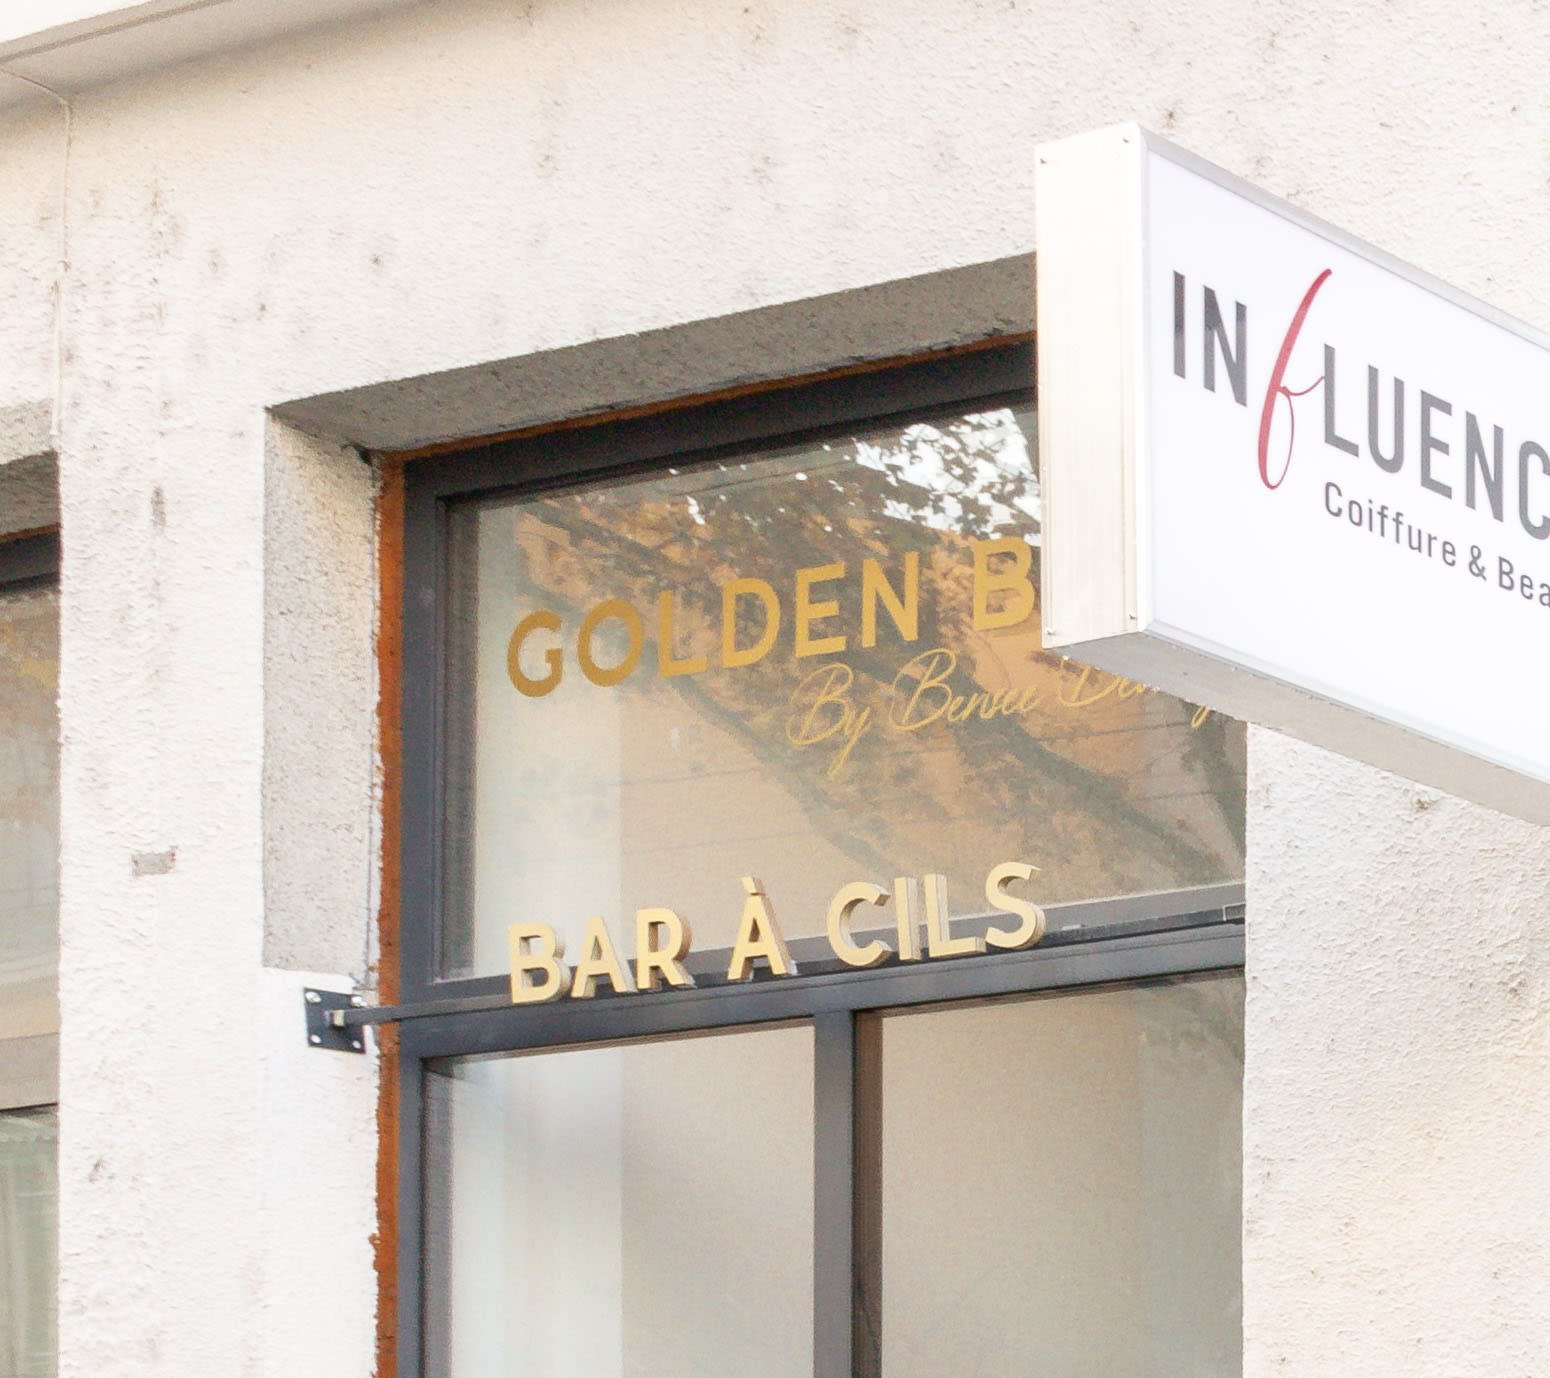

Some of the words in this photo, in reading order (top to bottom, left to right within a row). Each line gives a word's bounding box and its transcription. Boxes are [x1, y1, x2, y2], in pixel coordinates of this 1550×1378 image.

[1324, 481, 1457, 570] Coiffure
[1467, 544, 1488, 582] &
[506, 550, 922, 698] GOLDEN
[787, 662, 871, 777] By
[508, 906, 696, 1004] BAR
[727, 876, 797, 981] À
[826, 861, 1048, 968] CILS
